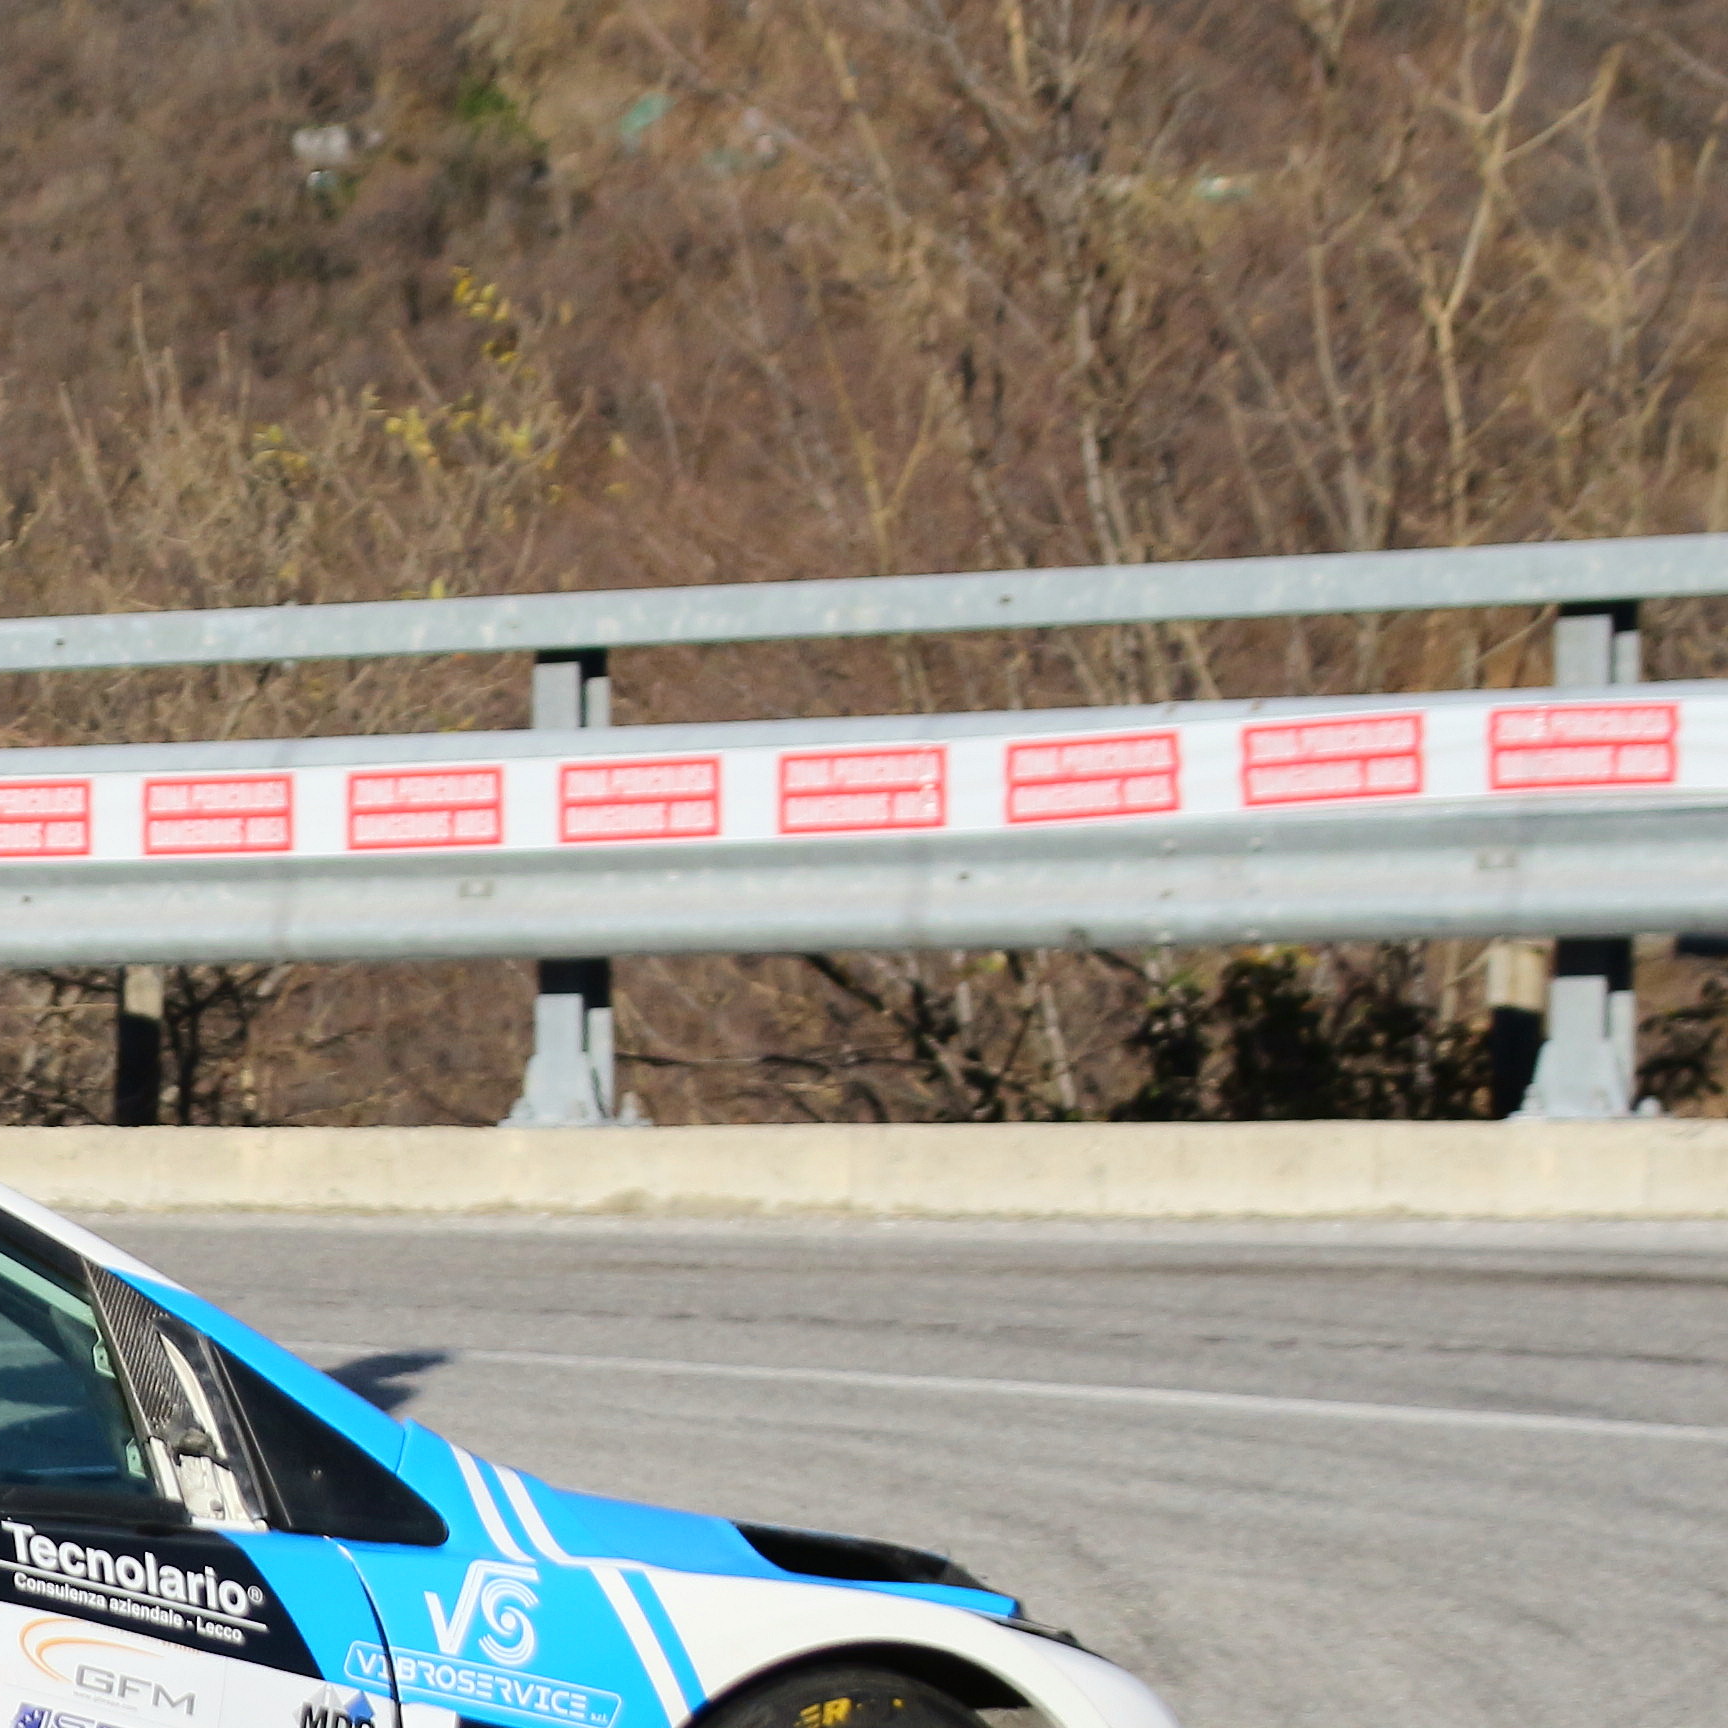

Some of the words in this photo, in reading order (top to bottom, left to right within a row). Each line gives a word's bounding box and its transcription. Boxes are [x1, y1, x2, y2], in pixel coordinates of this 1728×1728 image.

[13, 1571, 109, 1612] Consulenza
[109, 1594, 184, 1630] aziendale
[195, 1614, 243, 1643] Lecco
[75, 1663, 197, 1717] GFM
[355, 1647, 590, 1722] VIBROSERVICE
